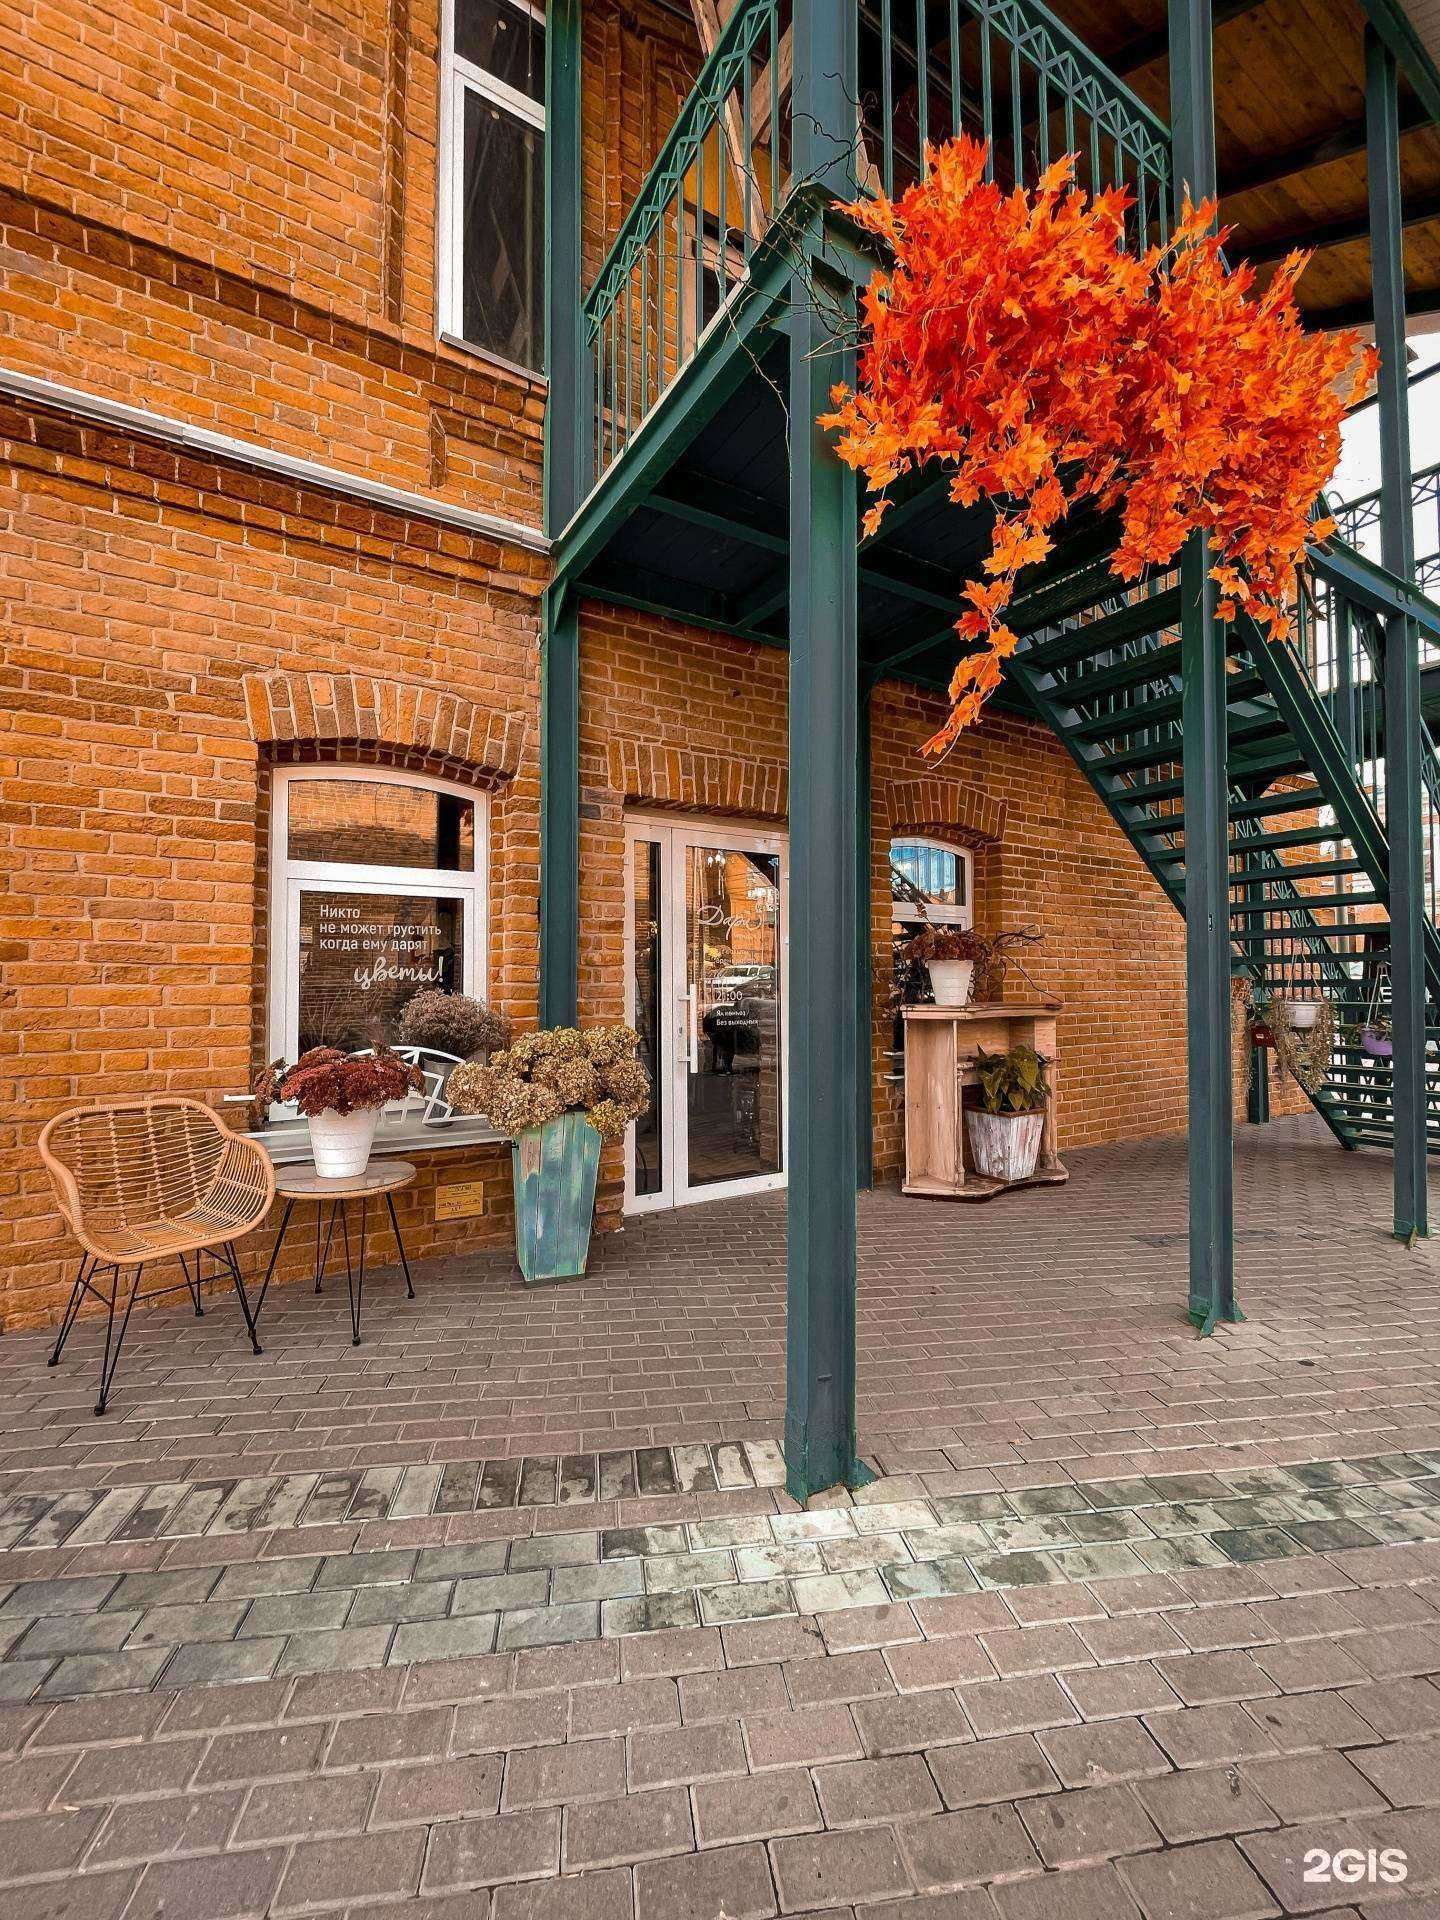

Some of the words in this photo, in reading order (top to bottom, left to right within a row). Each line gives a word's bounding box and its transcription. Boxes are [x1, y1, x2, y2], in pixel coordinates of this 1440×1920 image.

[320, 904, 360, 918] Никто
[320, 923, 336, 934] не
[341, 924, 384, 935] может
[388, 924, 442, 938] грустить
[320, 938, 358, 950] когда
[362, 940, 387, 952] ему
[391, 939, 428, 952] дарят
[353, 956, 444, 990] цветы!
